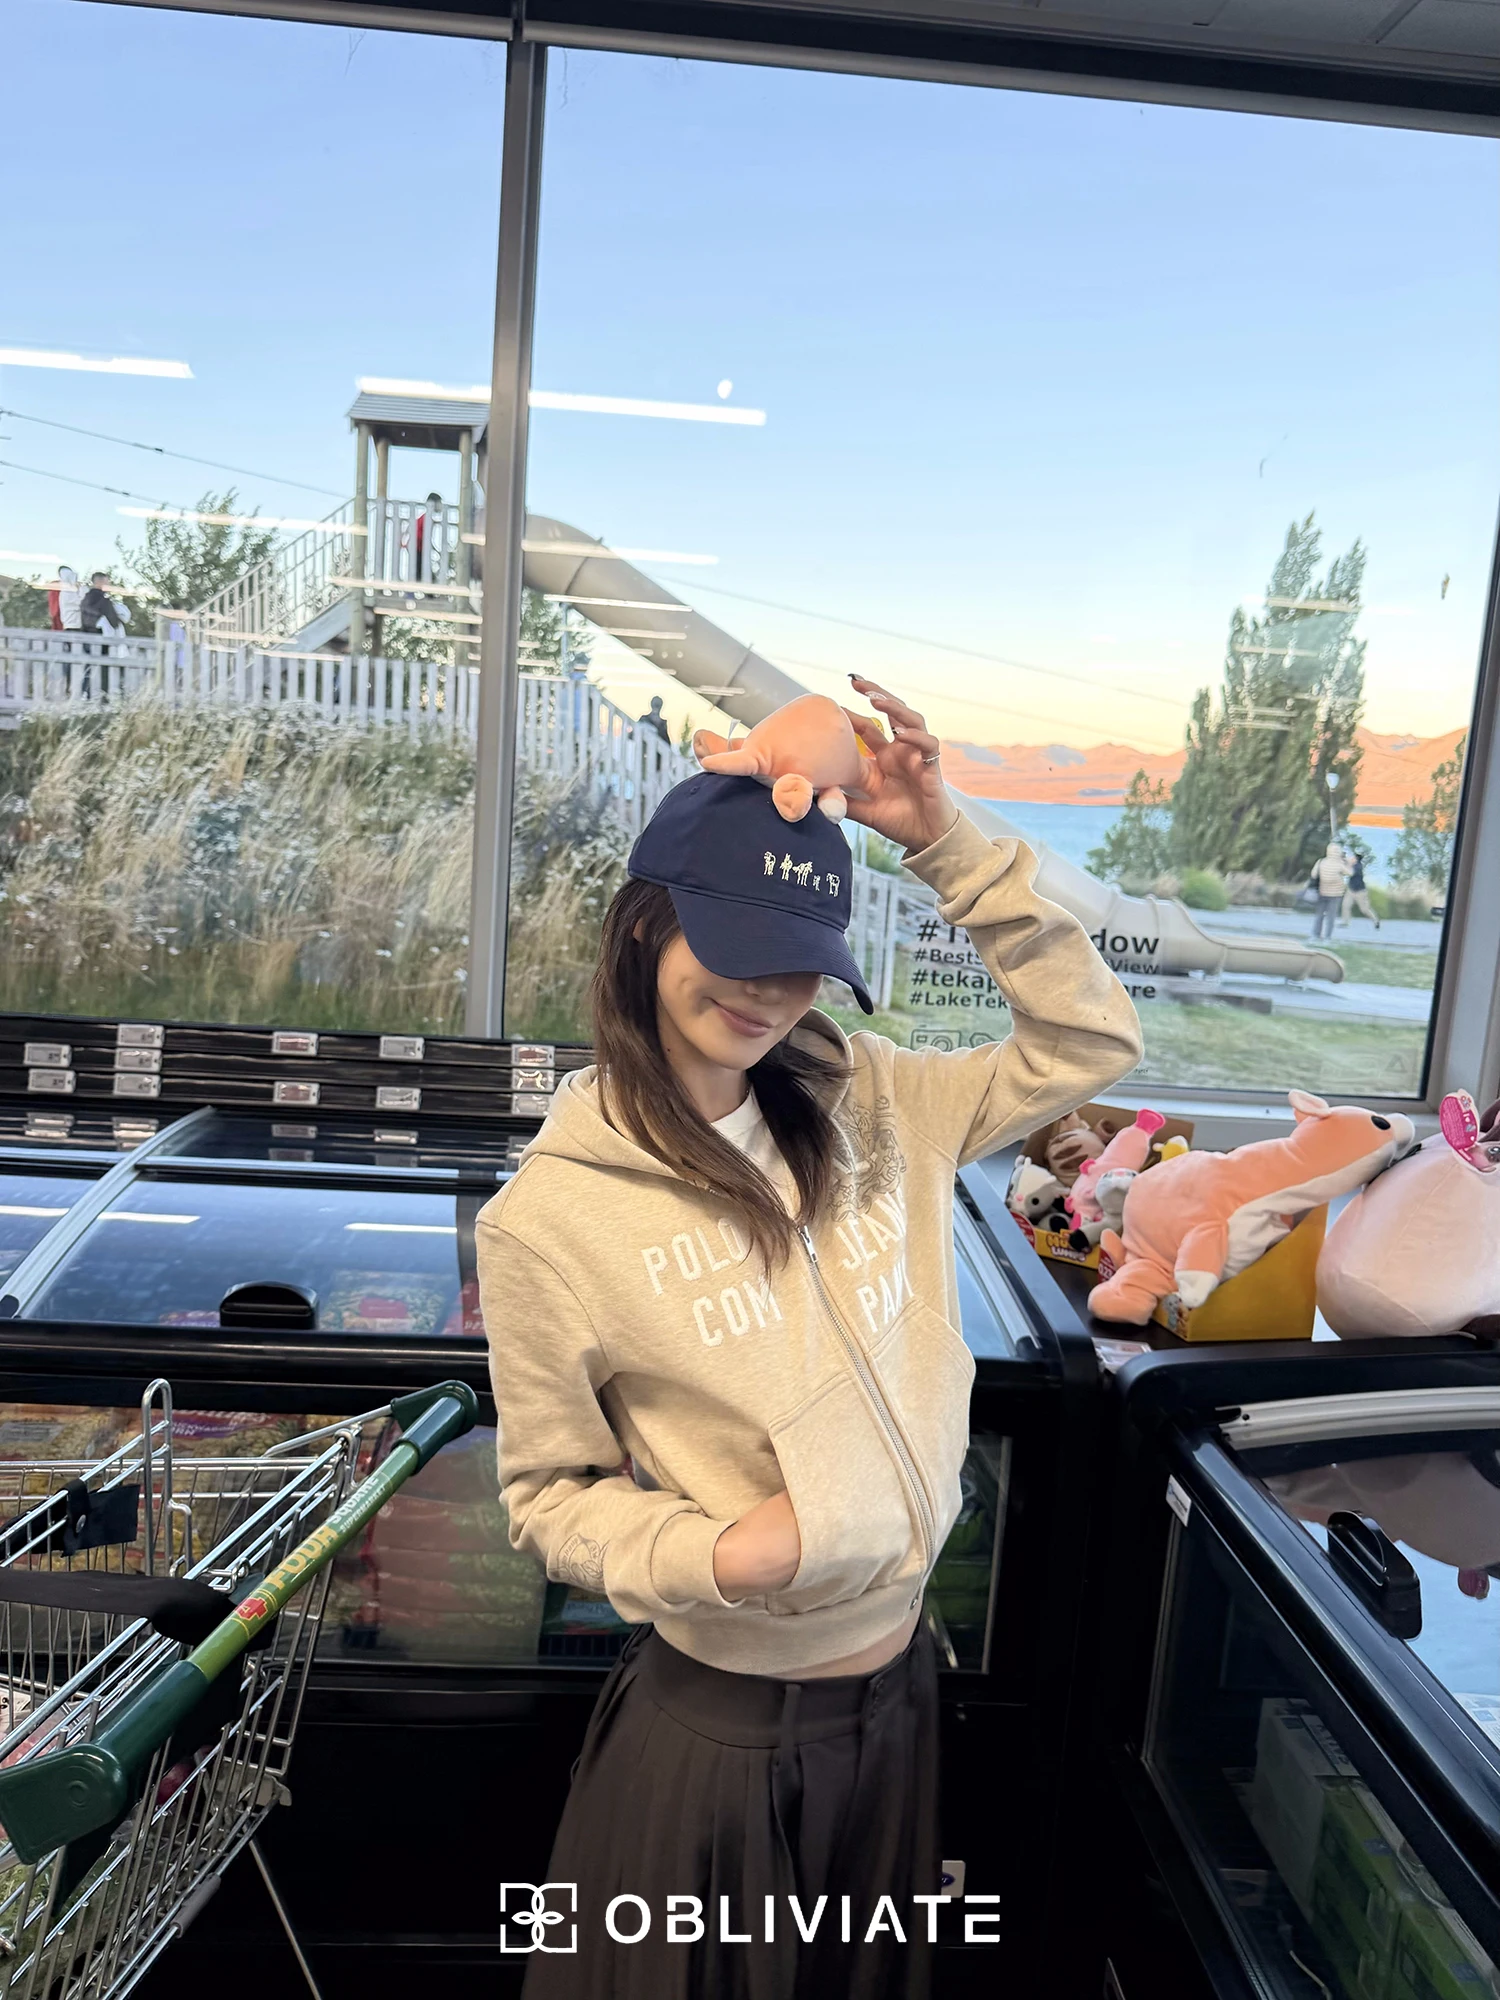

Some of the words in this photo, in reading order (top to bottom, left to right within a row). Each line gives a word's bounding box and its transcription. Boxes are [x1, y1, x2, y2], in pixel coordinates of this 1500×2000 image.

[641, 1217, 747, 1296] POLO
[692, 1280, 784, 1348] COM
[263, 1525, 340, 1591] FOUR
[327, 1476, 380, 1524] SQUARE
[340, 1485, 386, 1533] SUPERMARKET
